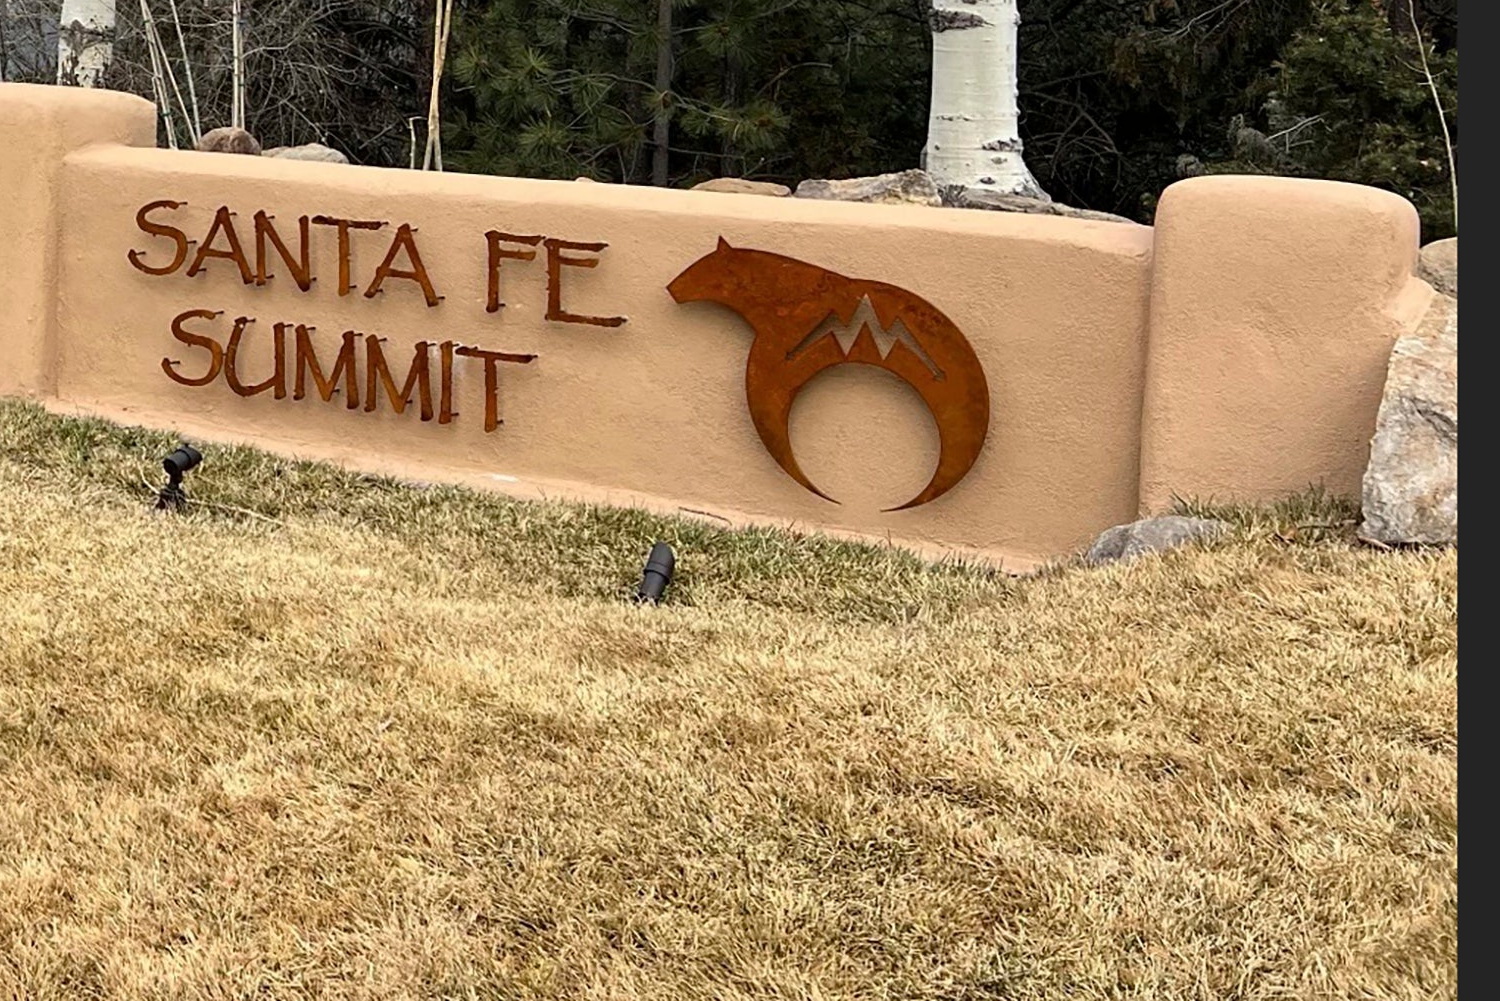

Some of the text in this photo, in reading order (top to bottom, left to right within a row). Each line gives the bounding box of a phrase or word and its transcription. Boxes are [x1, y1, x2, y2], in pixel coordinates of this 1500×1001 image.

[127, 199, 627, 328] SANTA FE
[161, 309, 538, 432] SUMMIT
